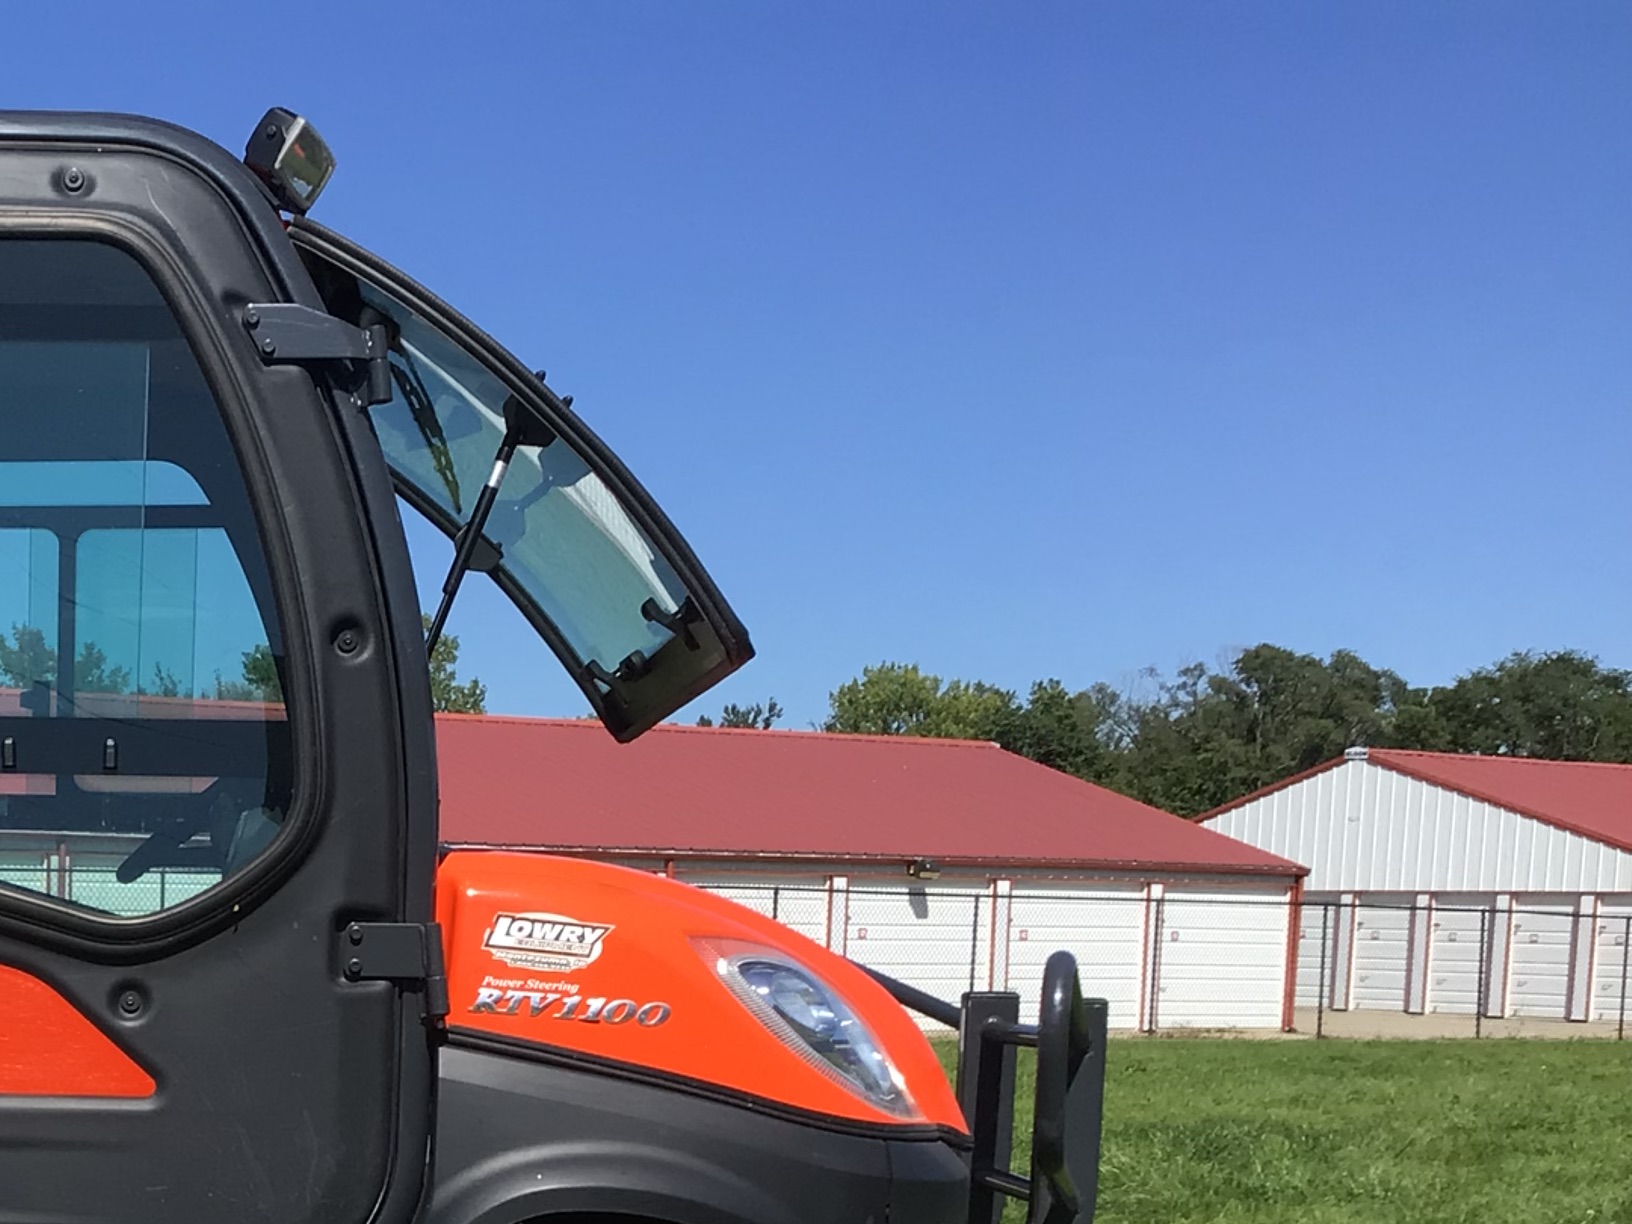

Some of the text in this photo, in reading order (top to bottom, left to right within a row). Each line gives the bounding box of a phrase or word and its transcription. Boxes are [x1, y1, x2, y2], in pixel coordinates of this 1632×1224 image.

[487, 916, 606, 947] LOWRY
[481, 976, 580, 993] Power Steering
[468, 987, 672, 1028] RTV1100
